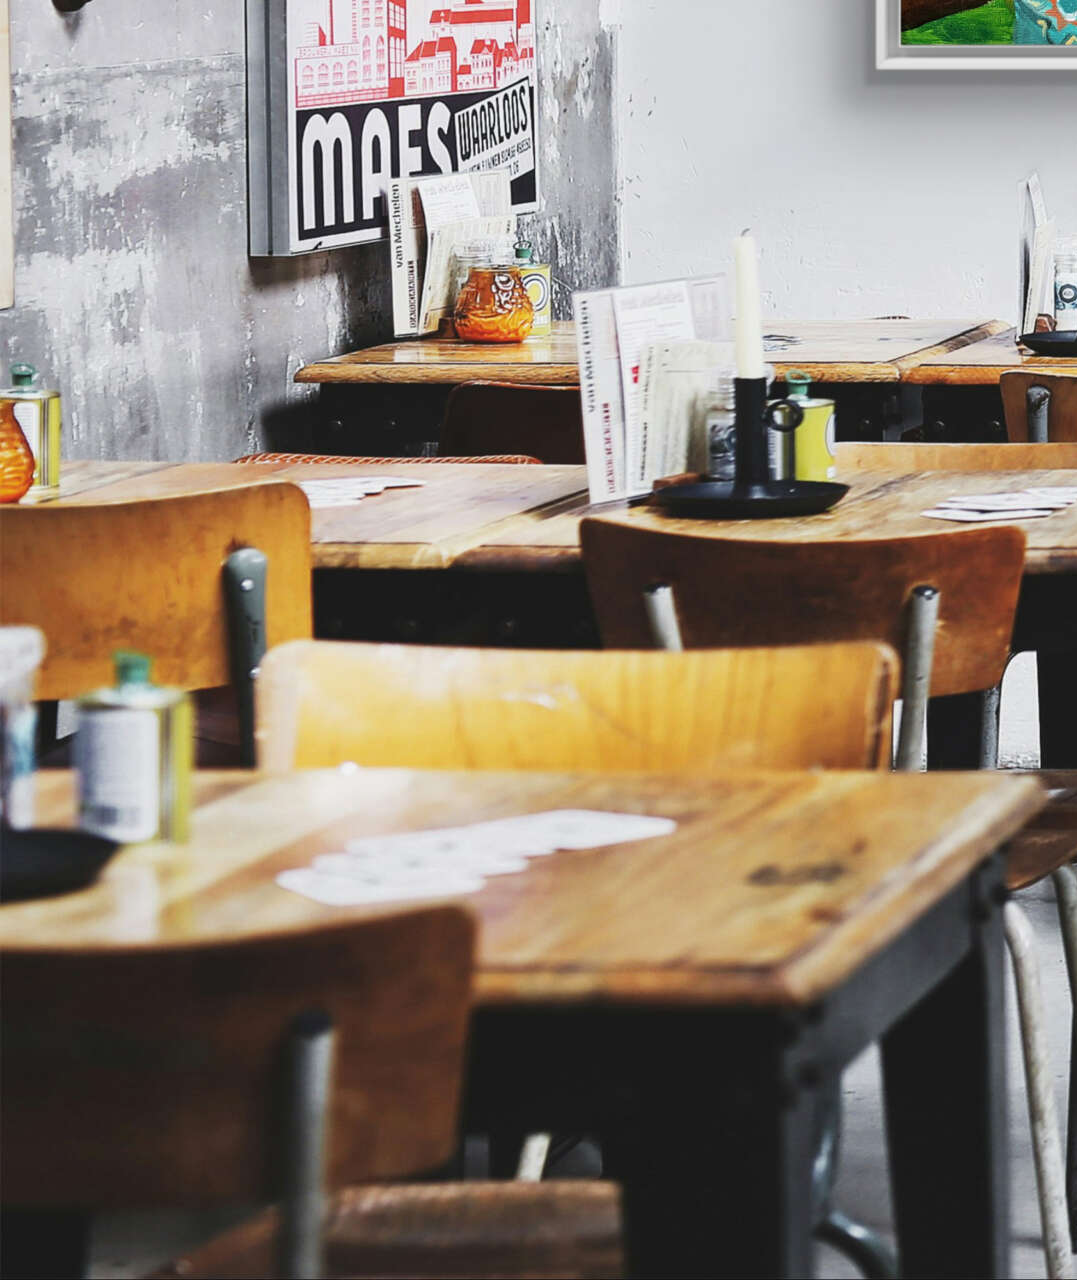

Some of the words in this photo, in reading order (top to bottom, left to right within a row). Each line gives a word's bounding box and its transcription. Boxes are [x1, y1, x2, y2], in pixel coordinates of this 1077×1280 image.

[457, 85, 528, 162] WAARLOOS
[301, 101, 452, 231] MAES
[391, 183, 404, 244] Mechelen
[395, 244, 404, 269] van
